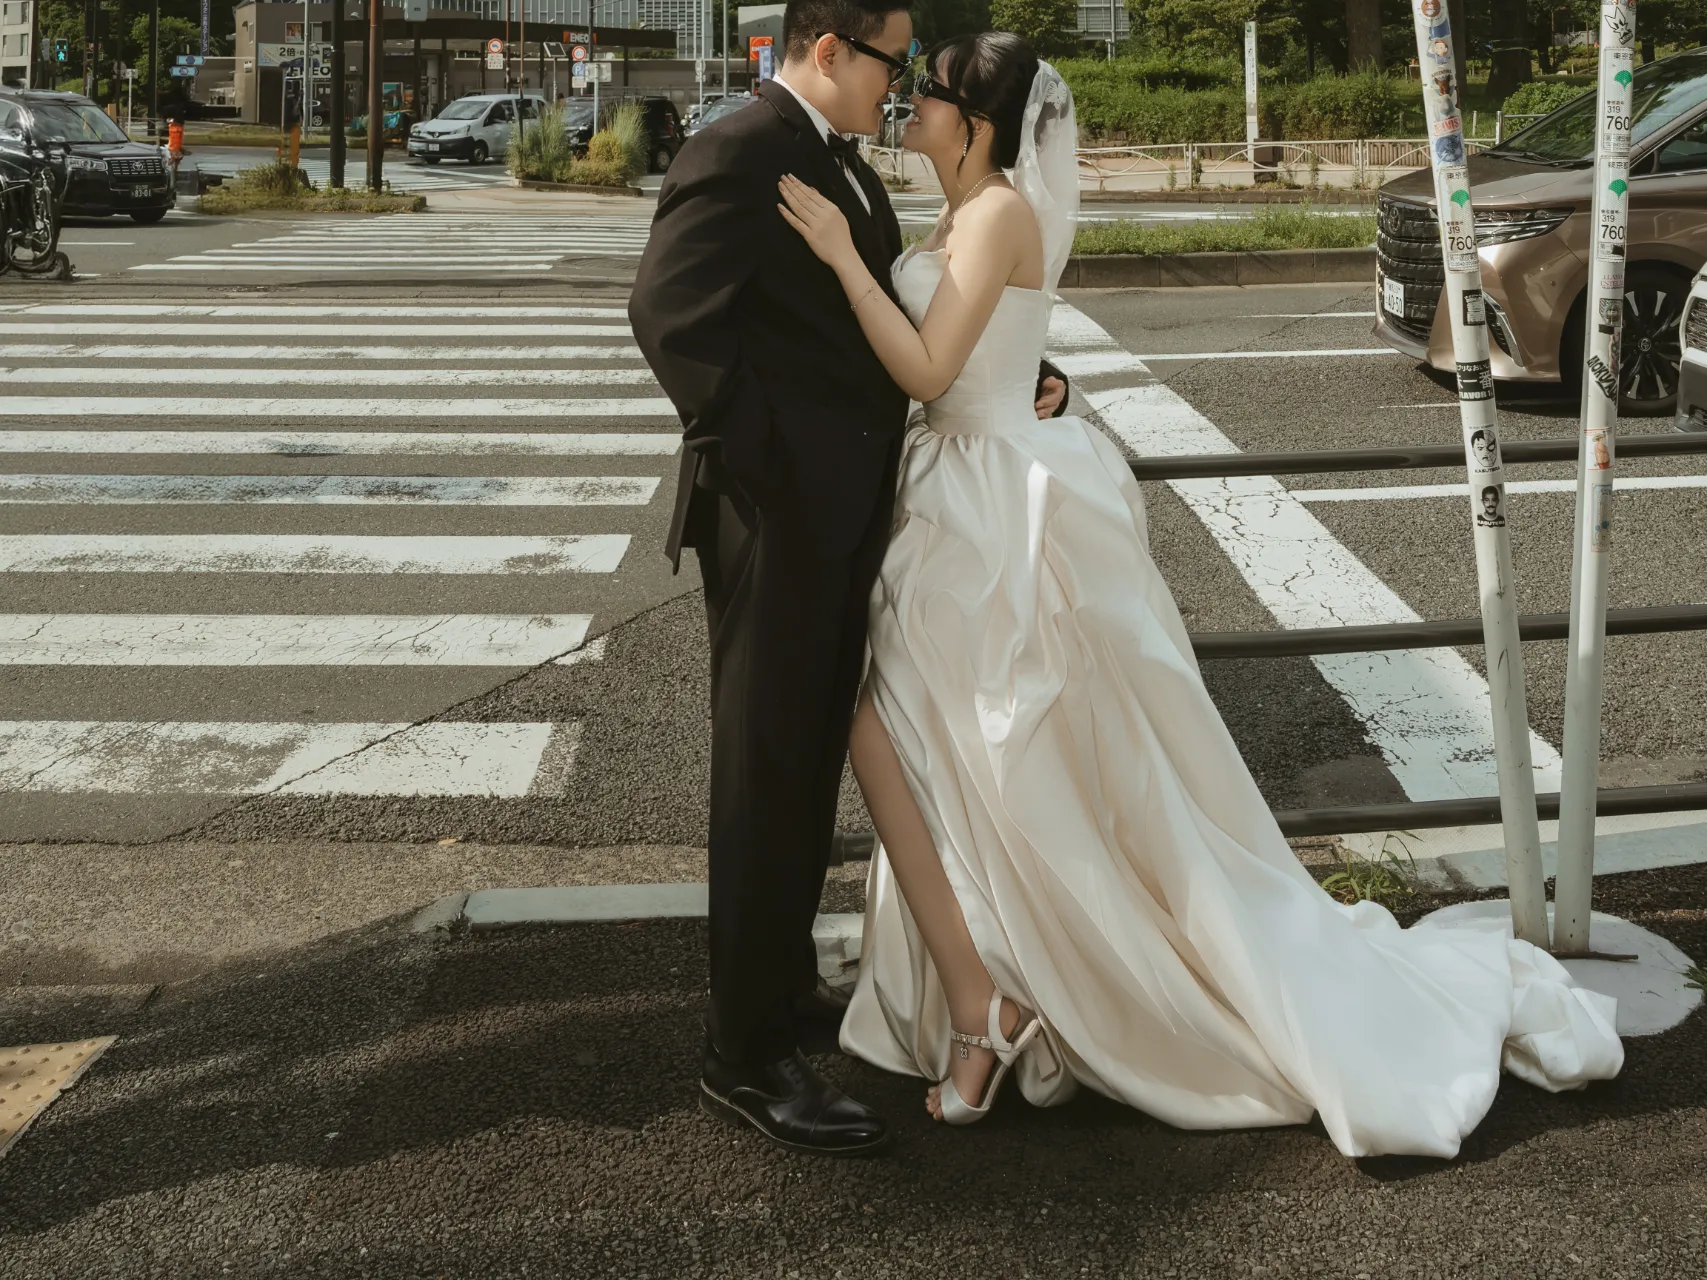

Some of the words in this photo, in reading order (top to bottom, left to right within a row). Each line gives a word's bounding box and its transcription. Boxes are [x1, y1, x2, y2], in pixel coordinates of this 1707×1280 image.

[570, 33, 589, 43] ENEO
[1607, 105, 1621, 114] 319
[1606, 116, 1630, 131] 760
[1601, 214, 1615, 223] 319
[1448, 226, 1461, 235] 319
[1601, 224, 1625, 240] 760
